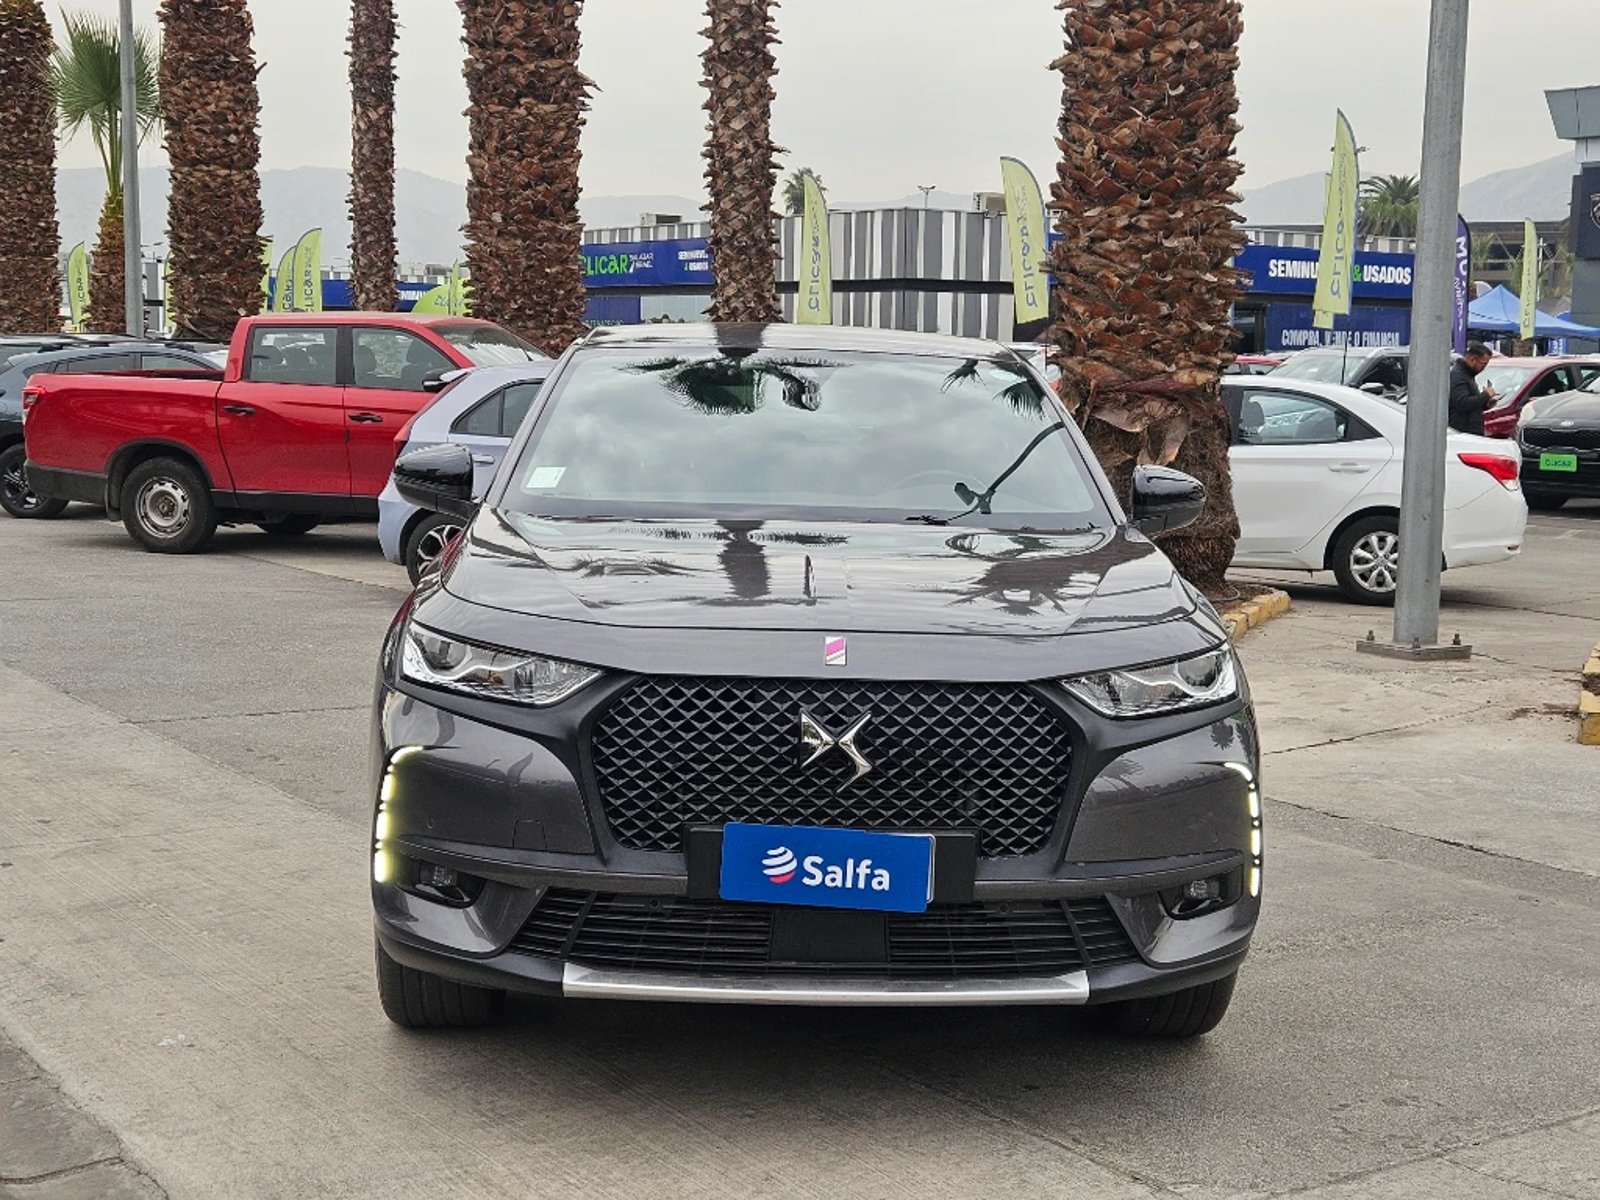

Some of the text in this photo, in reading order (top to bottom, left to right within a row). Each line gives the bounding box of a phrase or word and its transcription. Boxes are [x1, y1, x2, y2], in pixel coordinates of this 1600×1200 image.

[1268, 258, 1412, 285] SEMINU & USADOS
[802, 855, 890, 892] Salfa
